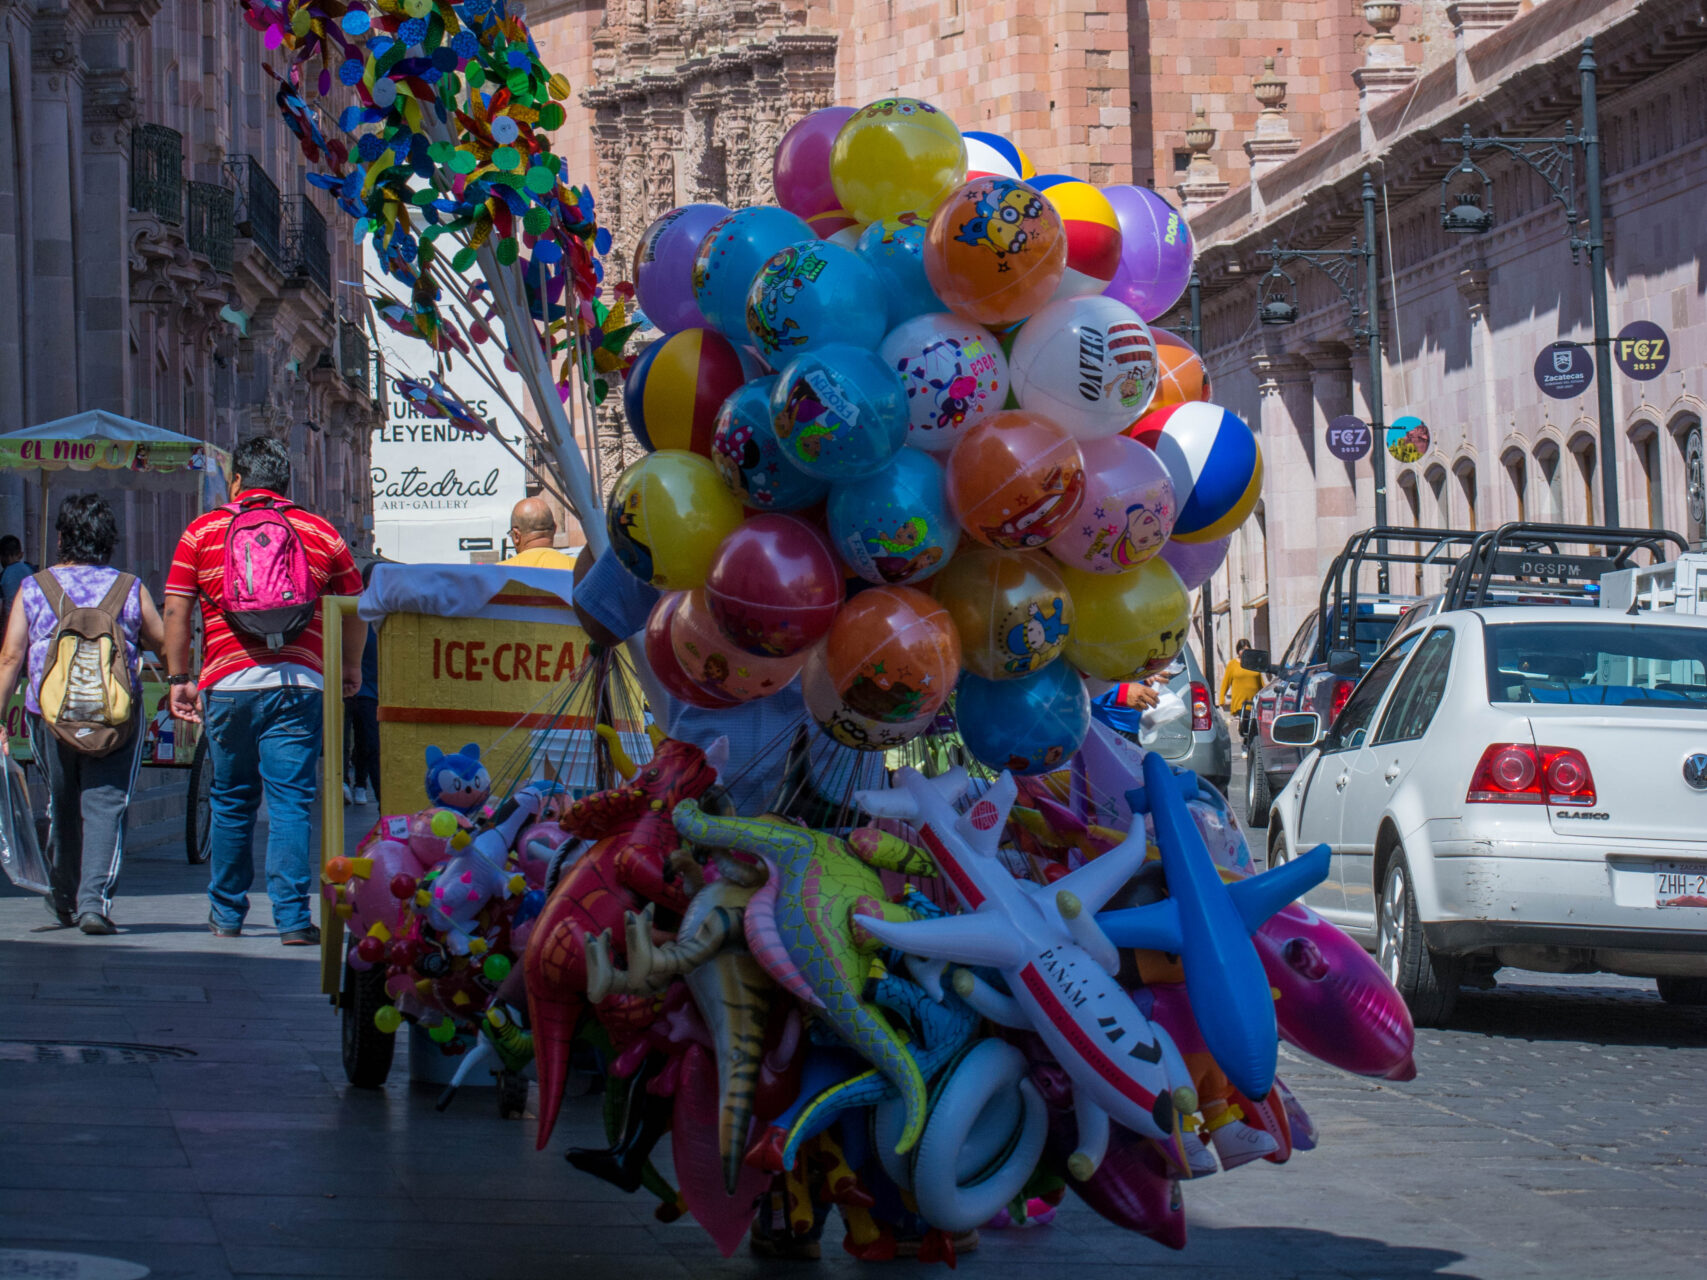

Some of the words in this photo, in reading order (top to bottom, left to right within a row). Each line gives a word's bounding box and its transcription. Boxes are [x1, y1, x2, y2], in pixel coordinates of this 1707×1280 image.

[1164, 212, 1178, 246] DORA
[794, 252, 819, 278] TOY
[1621, 339, 1665, 361] FCZ
[1079, 326, 1104, 401] CHAVO
[1544, 372, 1584, 382] Zacatecas
[810, 375, 854, 419] FROZEN
[1330, 429, 1367, 446] FCZ
[371, 466, 499, 498] Catedral
[380, 499, 469, 510] ART-GALLERY
[1556, 811, 1610, 820] CLASICO
[1658, 874, 1707, 894] ZHH-2
